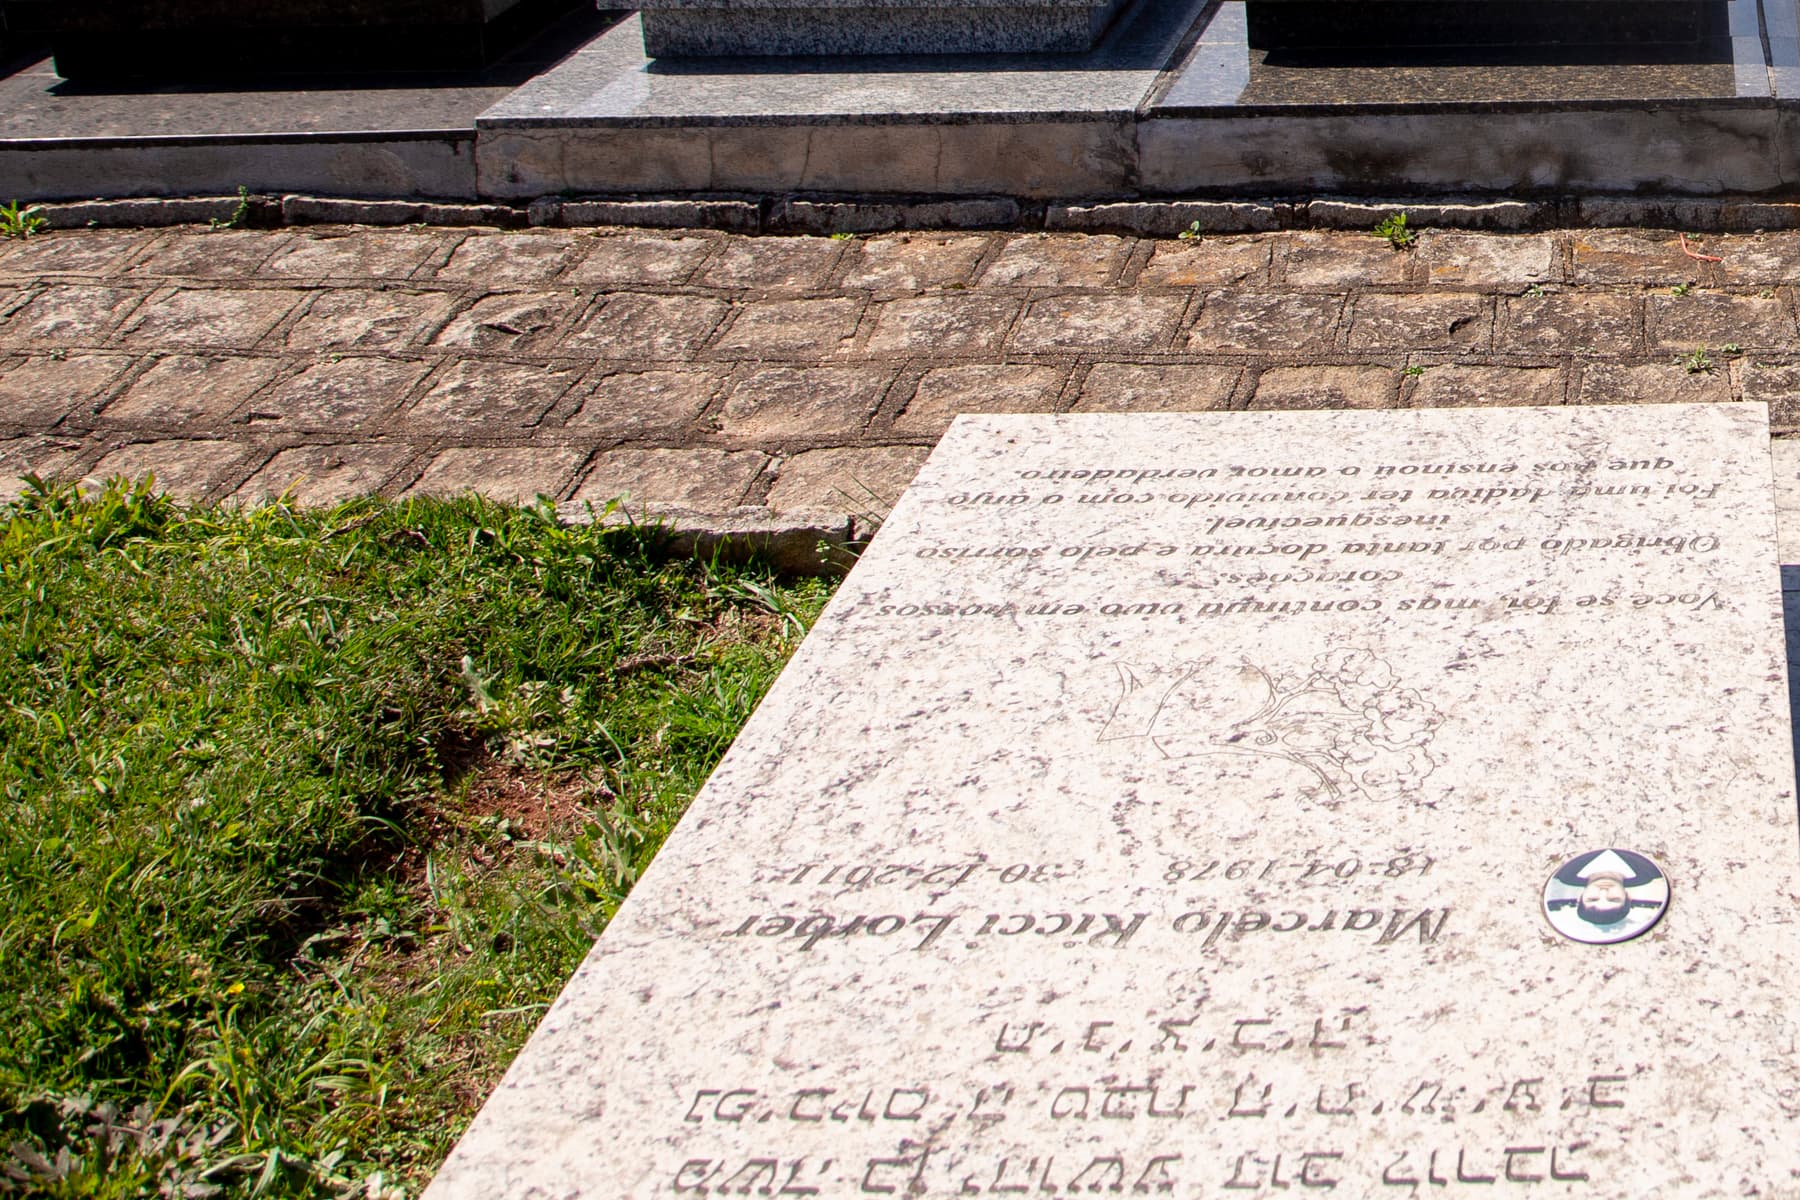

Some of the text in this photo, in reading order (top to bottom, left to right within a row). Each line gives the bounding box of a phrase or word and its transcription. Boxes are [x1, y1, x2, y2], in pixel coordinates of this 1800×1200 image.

[1013, 456, 1675, 485] que nos ensinou o amor verdadeiro.
[947, 482, 1722, 510] Foi uma dádiva ter convivido com o anjo
[914, 534, 1721, 565] Obrigado por tanta doçura e pelo sorriso
[874, 603, 1012, 619] nossos
[1024, 602, 1086, 616] em
[1098, 602, 1184, 621] vivo
[1196, 599, 1383, 618] continua
[1397, 597, 1481, 613] mas
[1575, 594, 1615, 609] se
[1631, 591, 1722, 612] Você
[1161, 854, 1437, 883] 18-04-1978
[720, 907, 1452, 953] Marcelo Ricci Lorber
